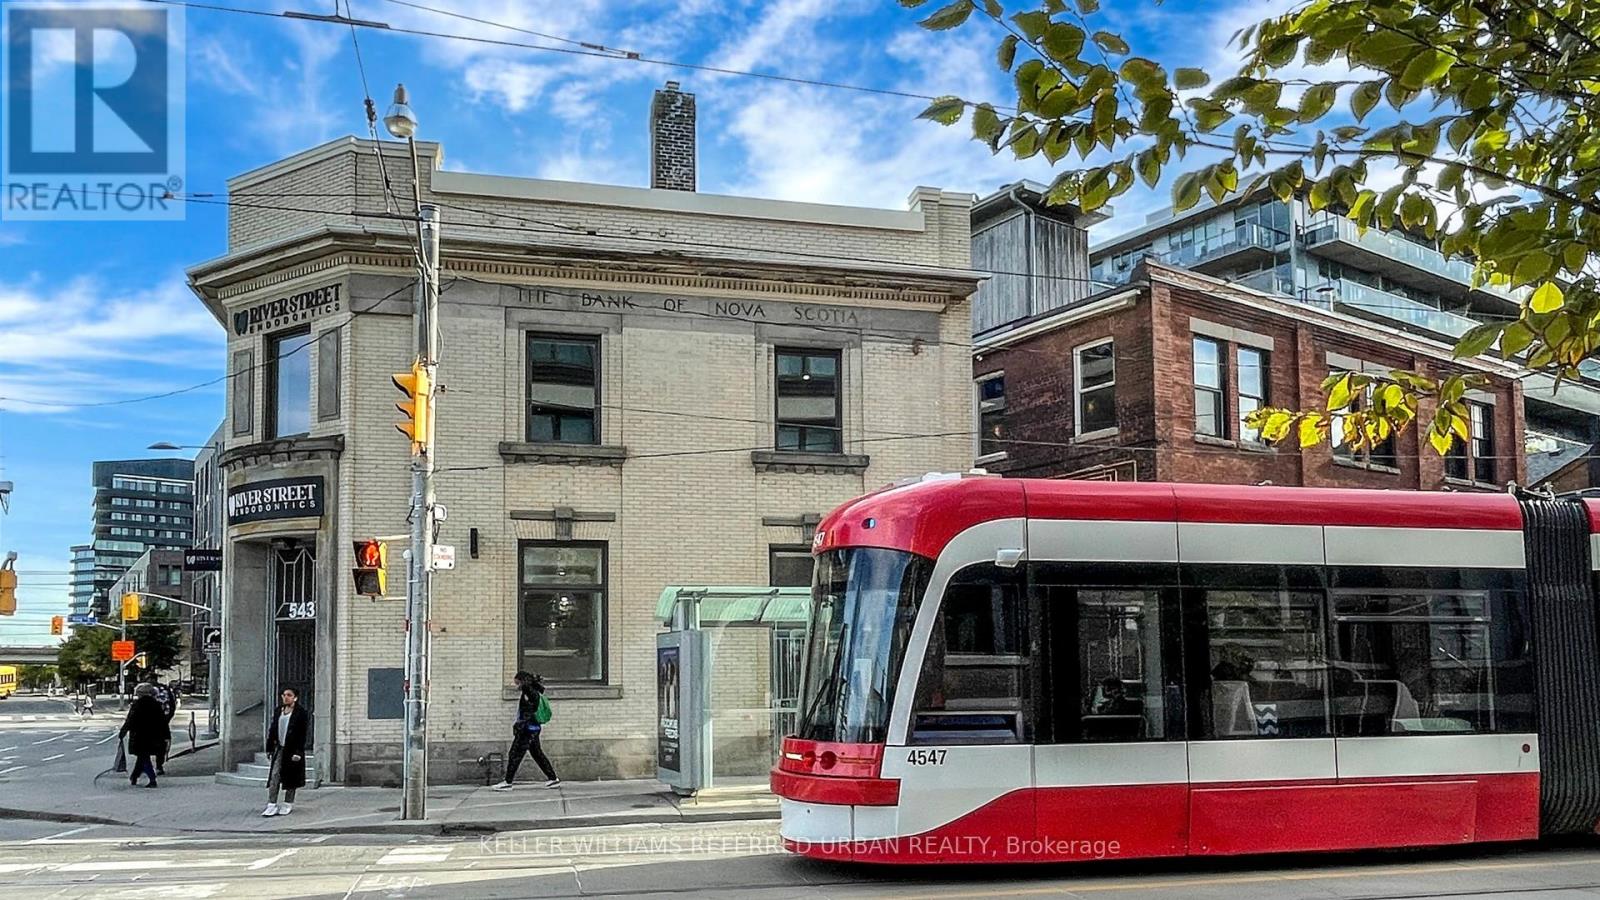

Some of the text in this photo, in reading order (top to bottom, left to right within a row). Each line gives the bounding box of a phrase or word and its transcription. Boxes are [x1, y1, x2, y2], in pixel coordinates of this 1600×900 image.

[249, 283, 342, 324] RIVER STREET
[517, 288, 859, 323] THE BANK OF NOVA SCOTIA
[249, 303, 340, 334] ENDODONTICS
[235, 484, 317, 508] RIVER STREET
[235, 500, 316, 517] ENDODONTICS
[289, 602, 316, 618] 543
[907, 750, 947, 765] 4547
